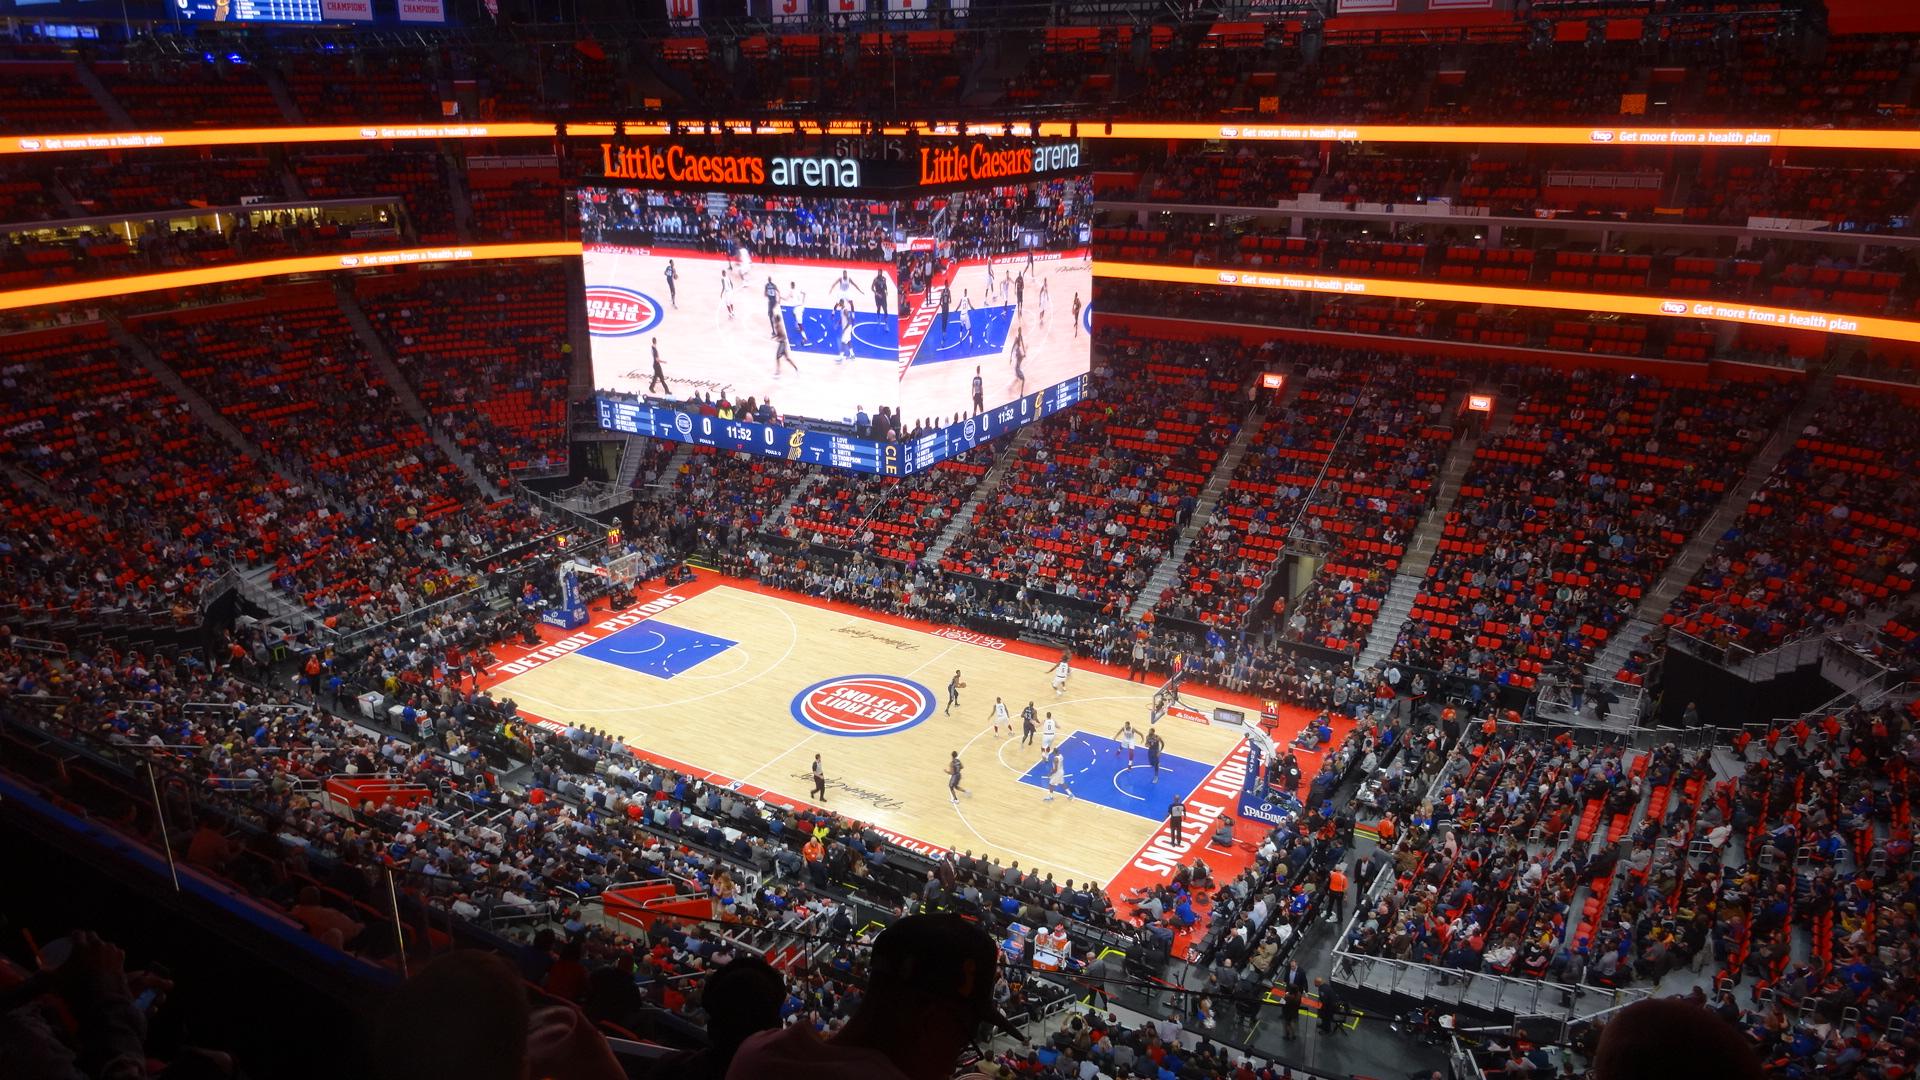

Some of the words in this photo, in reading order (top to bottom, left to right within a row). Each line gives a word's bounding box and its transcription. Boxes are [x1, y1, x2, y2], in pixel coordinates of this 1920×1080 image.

[327, 2, 367, 12] CHAMPIONS
[403, 5, 440, 14] CHAMPIONS
[381, 129, 395, 137] Get
[396, 129, 417, 137] more
[418, 128, 437, 136] from
[444, 127, 469, 135] health
[470, 128, 487, 137] plan
[1242, 129, 1257, 137] Get
[1258, 130, 1279, 138] more
[1281, 128, 1300, 138] from
[1309, 128, 1336, 138] health
[1338, 129, 1357, 140] plan
[1619, 132, 1638, 142] Get
[1640, 133, 1666, 142] more
[1670, 131, 1696, 142] from
[1698, 134, 1704, 142] a
[1709, 132, 1743, 142] health
[1745, 132, 1770, 144] plan
[45, 139, 61, 149] Get
[63, 140, 87, 148] more
[89, 137, 109, 147] from
[110, 138, 116, 146] a
[117, 136, 144, 146] health
[146, 136, 163, 146] plan
[601, 143, 665, 180] Little
[667, 144, 766, 185] Caesars
[771, 156, 860, 188] arena
[920, 145, 969, 186] Little
[971, 142, 1032, 181] Caesars
[1034, 143, 1080, 173] arena
[364, 256, 378, 264] Get
[380, 255, 399, 263] more
[401, 252, 420, 262] from
[428, 250, 453, 259] health
[454, 250, 472, 259] plan
[1241, 275, 1256, 284] Get
[1258, 277, 1281, 285] more
[1283, 276, 1305, 287] from
[1306, 280, 1311, 288] a
[1314, 279, 1342, 290] health
[1344, 282, 1365, 292] plan
[1693, 304, 1712, 315] Get
[1716, 306, 1744, 318] more
[1748, 307, 1775, 322] from
[1778, 314, 1786, 323] a
[1789, 313, 1826, 328] health
[1829, 318, 1857, 331] plan
[600, 401, 611, 428] DET
[1021, 399, 1027, 415] 0
[983, 414, 989, 431] 0
[998, 409, 1014, 424] 11:52
[703, 417, 711, 435] 0
[726, 426, 751, 441] 11:52
[765, 427, 774, 445] 0
[837, 443, 855, 451] THOMAS
[815, 453, 820, 461] 7
[838, 456, 862, 464] THOMPSON
[885, 445, 897, 474] CLE
[904, 444, 913, 475] DET
[594, 593, 687, 632] PISTONS
[543, 614, 567, 629] SPALDING
[497, 631, 598, 675] DETROIT
[817, 696, 894, 722] DETROIT
[831, 687, 908, 714] PISTONS
[1243, 805, 1287, 824] SPALDING
